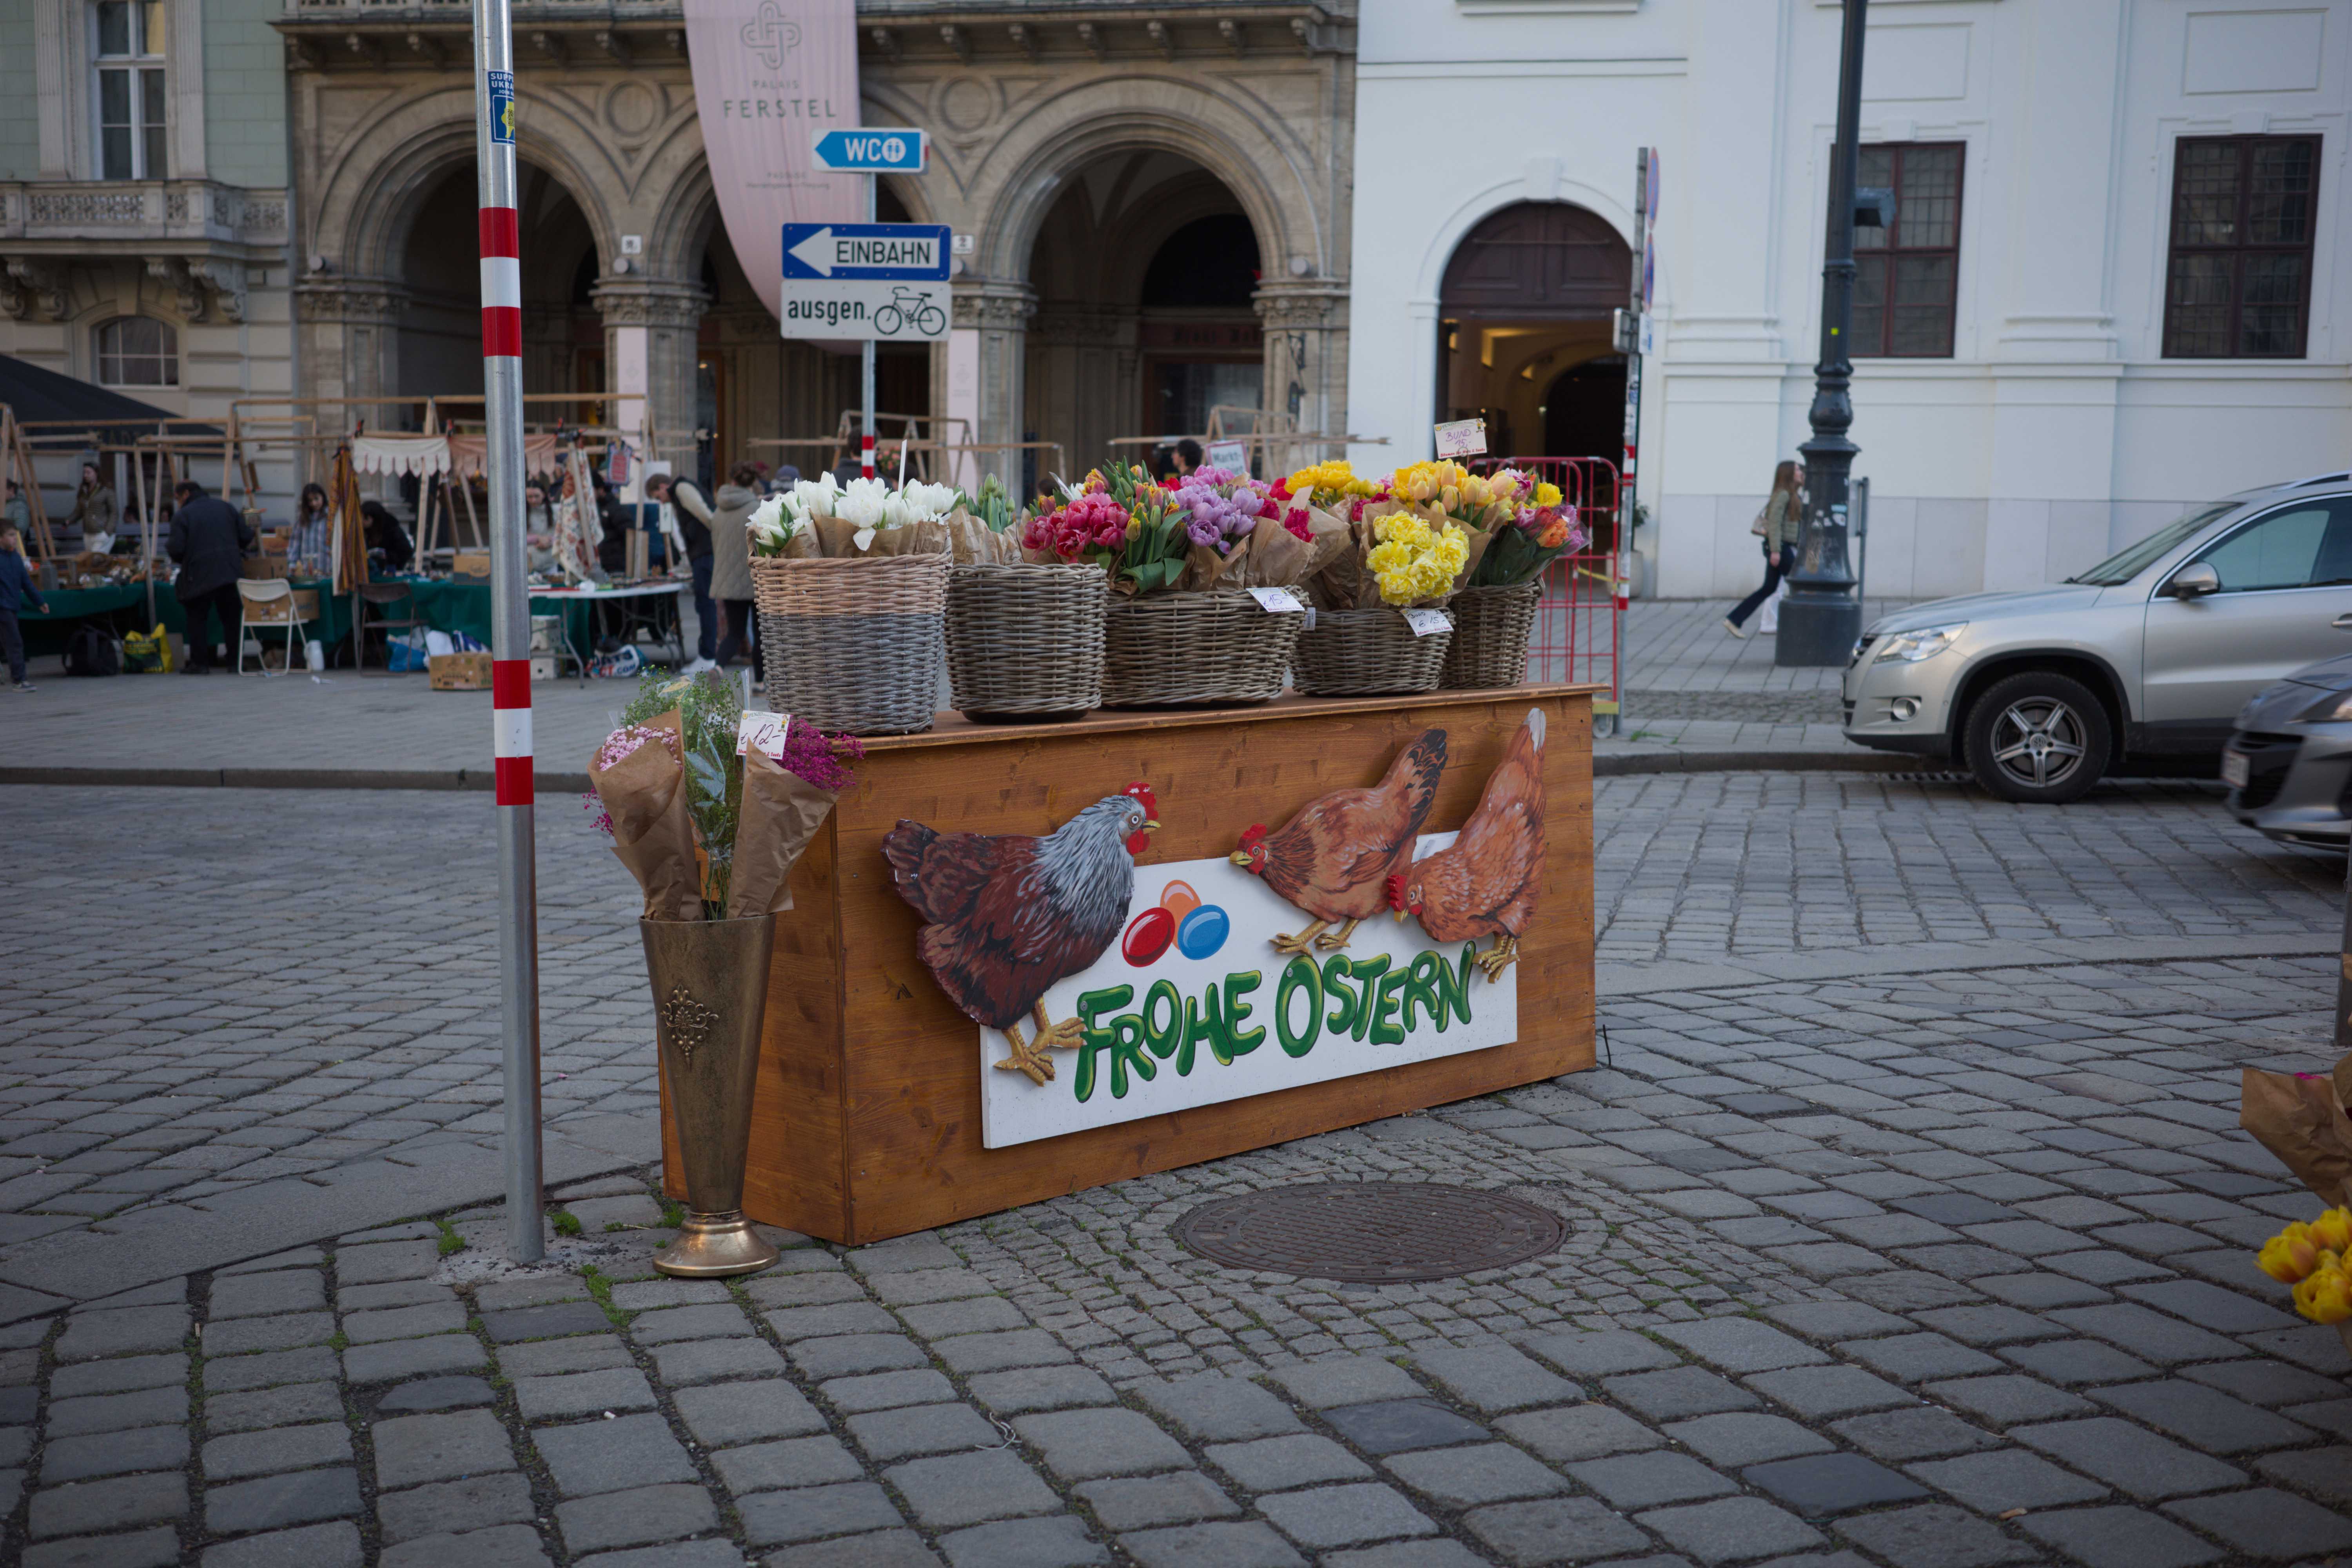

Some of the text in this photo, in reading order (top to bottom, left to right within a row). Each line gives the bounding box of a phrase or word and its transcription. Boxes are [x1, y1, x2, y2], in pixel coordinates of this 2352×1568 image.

[492, 81, 514, 89] UKRA
[753, 80, 799, 89] PALAIS
[723, 100, 836, 118] FERSTEL
[845, 138, 882, 162] WC
[837, 241, 930, 264] EINBAHN
[788, 300, 871, 326] ausgen.
[1446, 429, 1471, 441] BUND
[740, 733, 748, 744] €
[1074, 941, 1475, 1103] FROHE OSTERN
